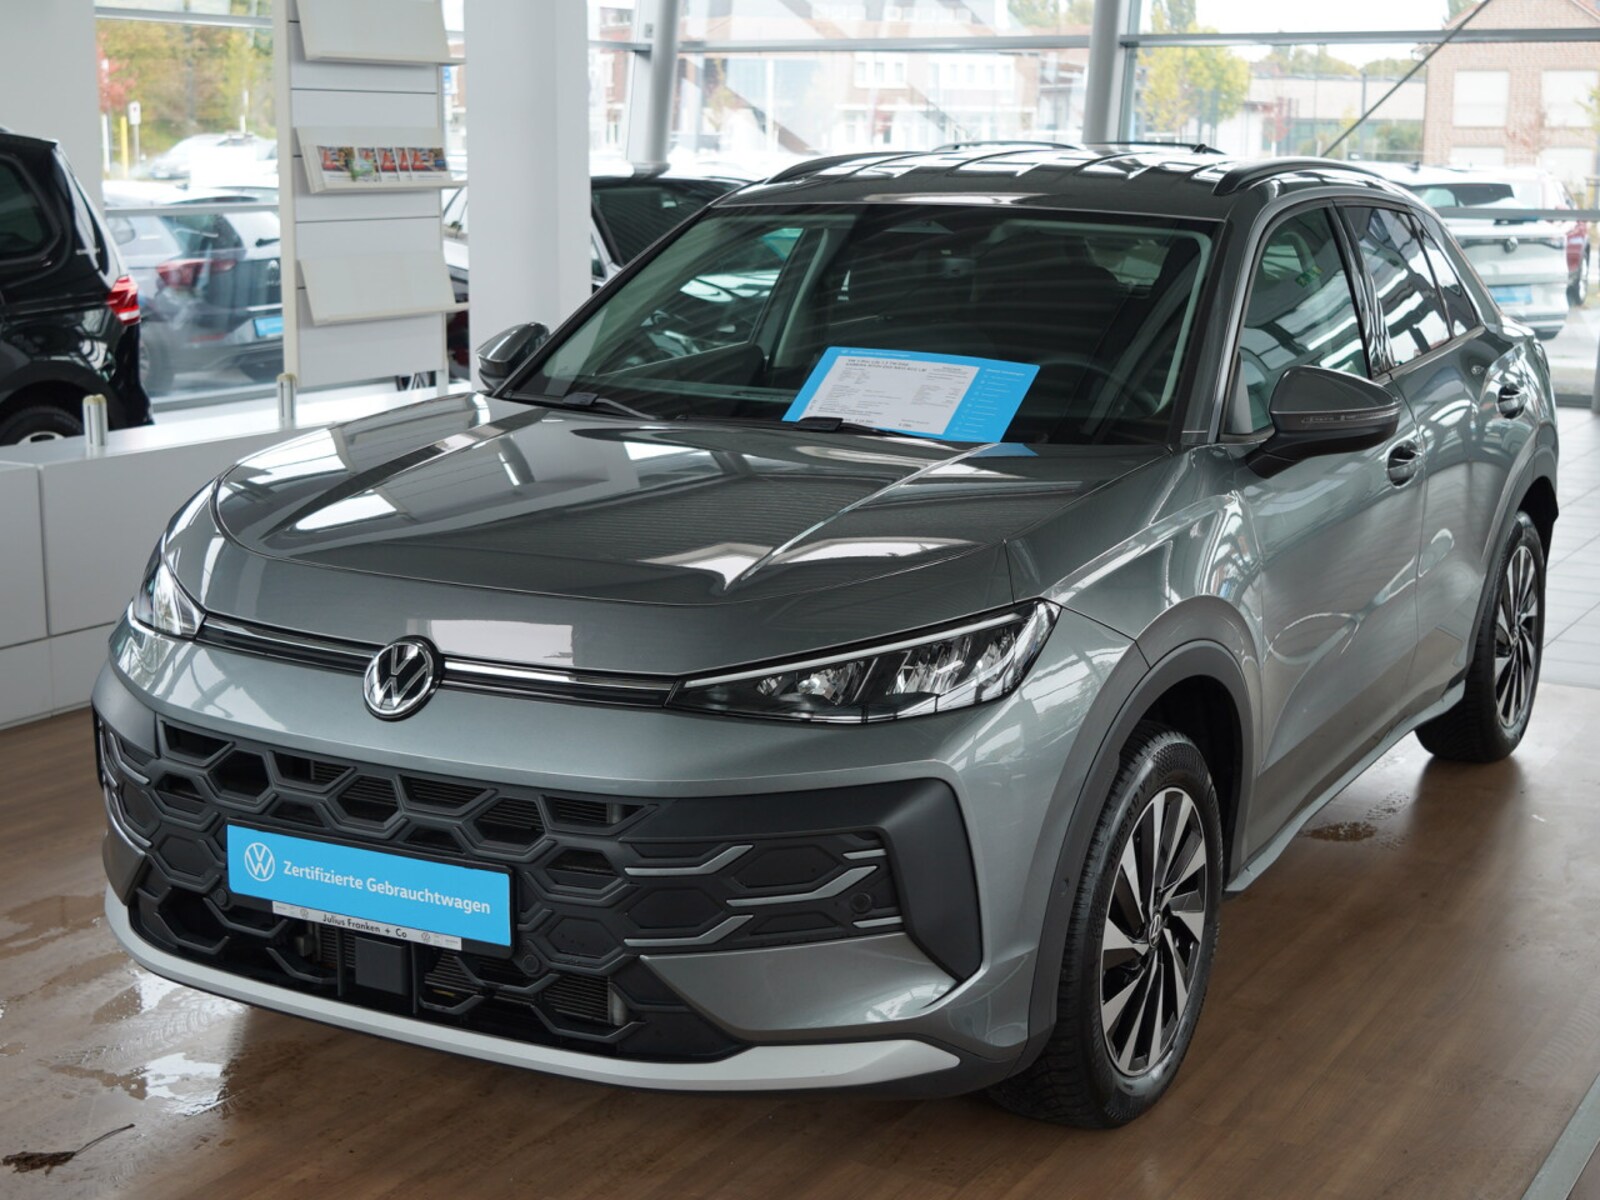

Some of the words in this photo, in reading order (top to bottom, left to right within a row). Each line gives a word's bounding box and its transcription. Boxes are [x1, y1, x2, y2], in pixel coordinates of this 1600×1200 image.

[364, 642, 434, 715] VW
[244, 842, 275, 882] VW
[283, 860, 363, 890] Zertifizierte
[366, 877, 491, 914] Gebrauchtwagen
[322, 914, 346, 926] Julius
[347, 918, 381, 933] Franken
[395, 928, 408, 939] Co
